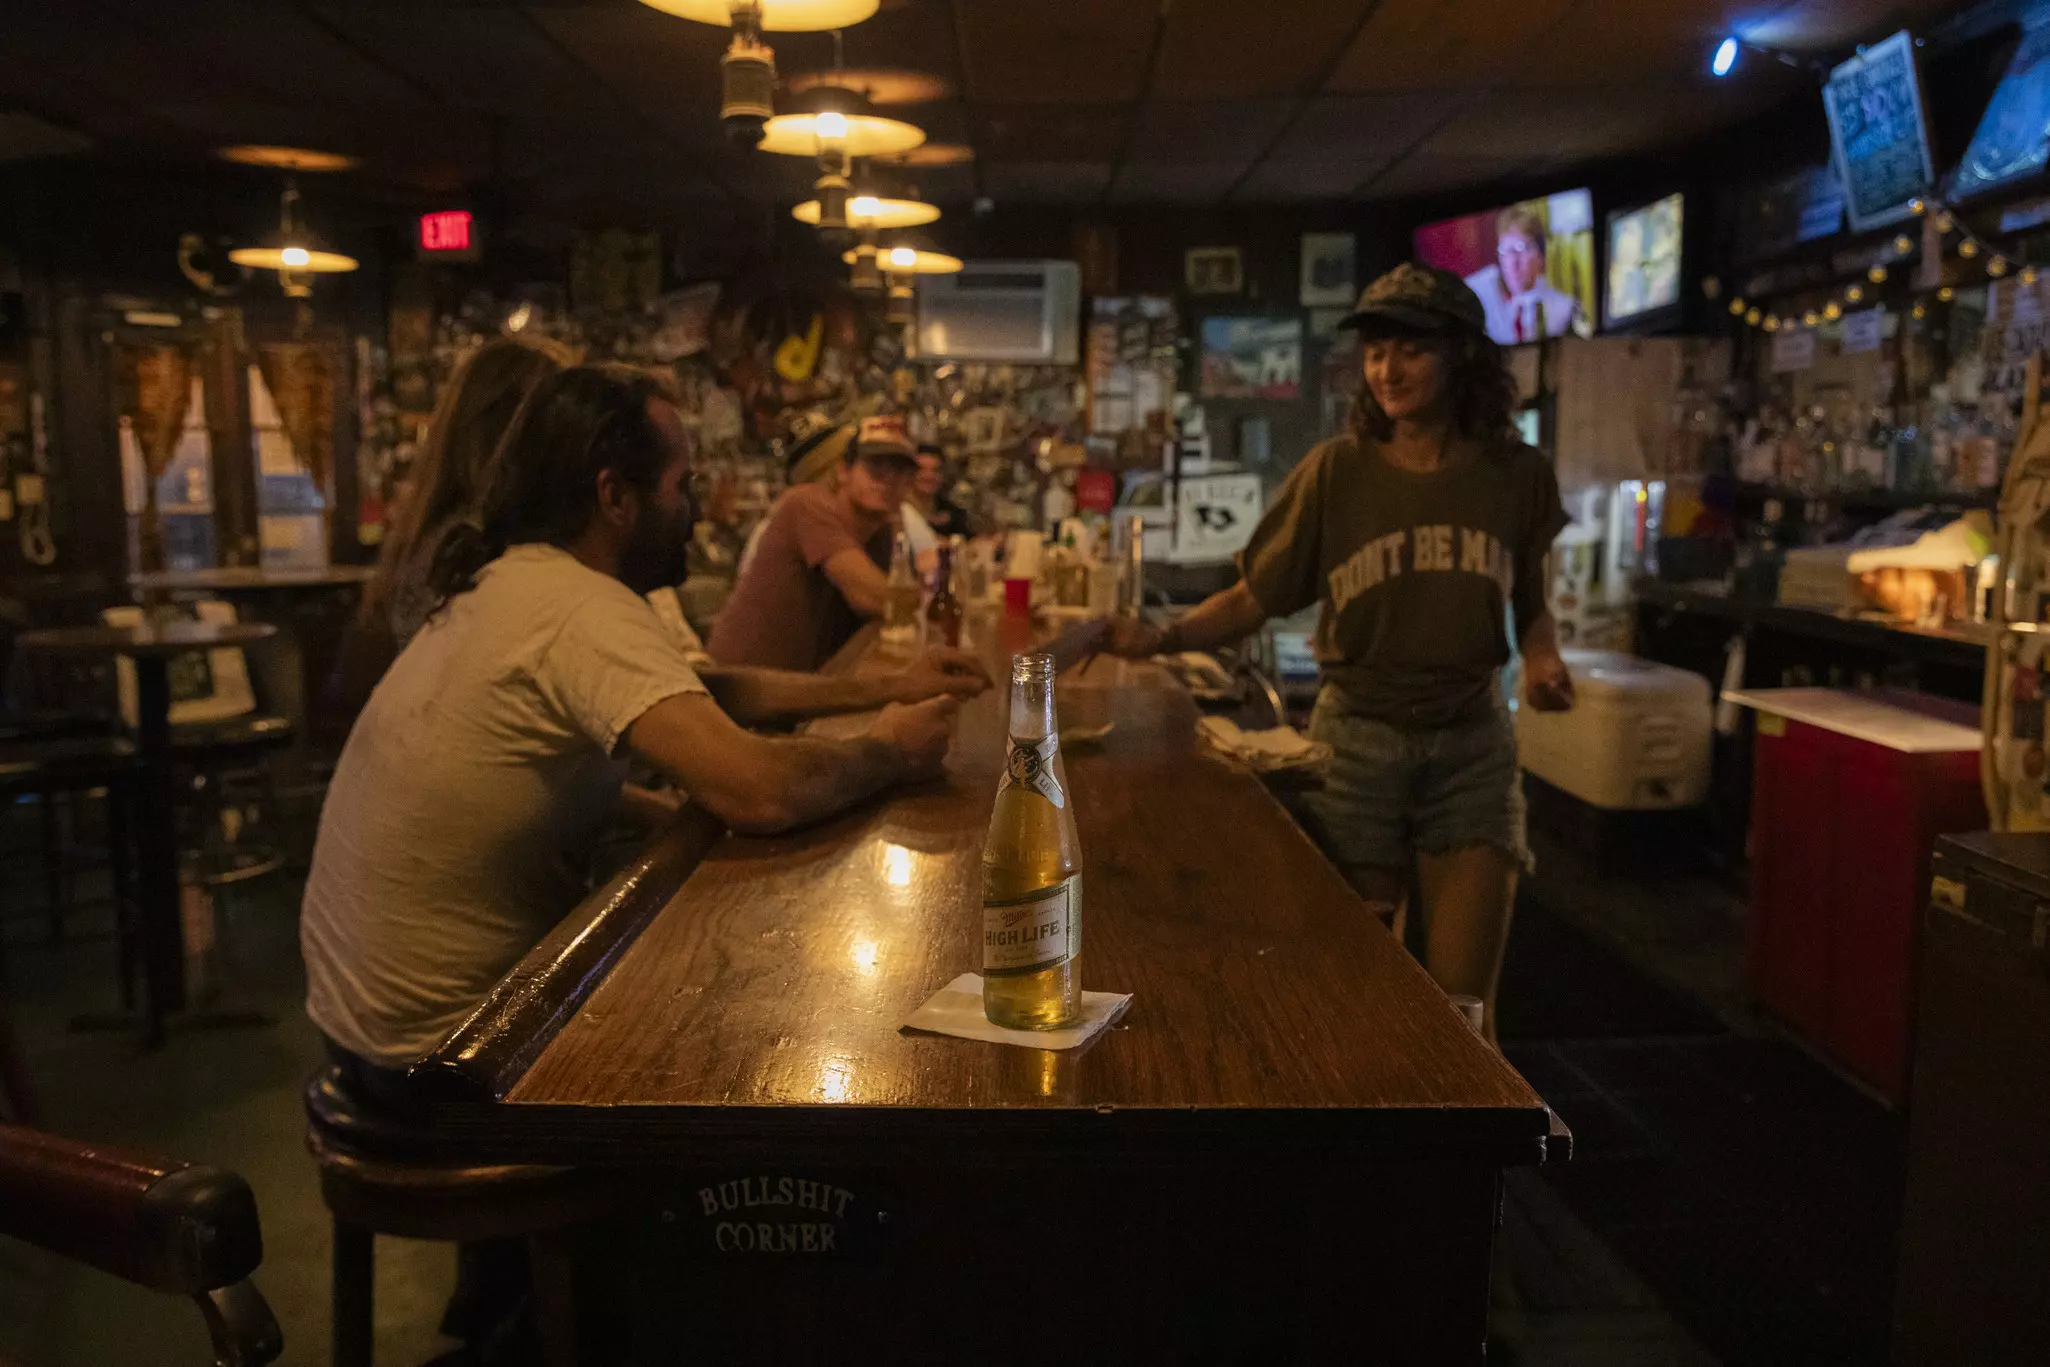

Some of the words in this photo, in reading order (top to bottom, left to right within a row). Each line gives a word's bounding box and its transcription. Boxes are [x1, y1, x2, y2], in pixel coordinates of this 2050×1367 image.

[1412, 523, 1455, 572] BE
[985, 929, 1019, 946] HIGH
[1021, 920, 1061, 943] LIFE
[698, 1175, 856, 1220] BULLSHIT
[715, 1221, 836, 1252] CORNER
